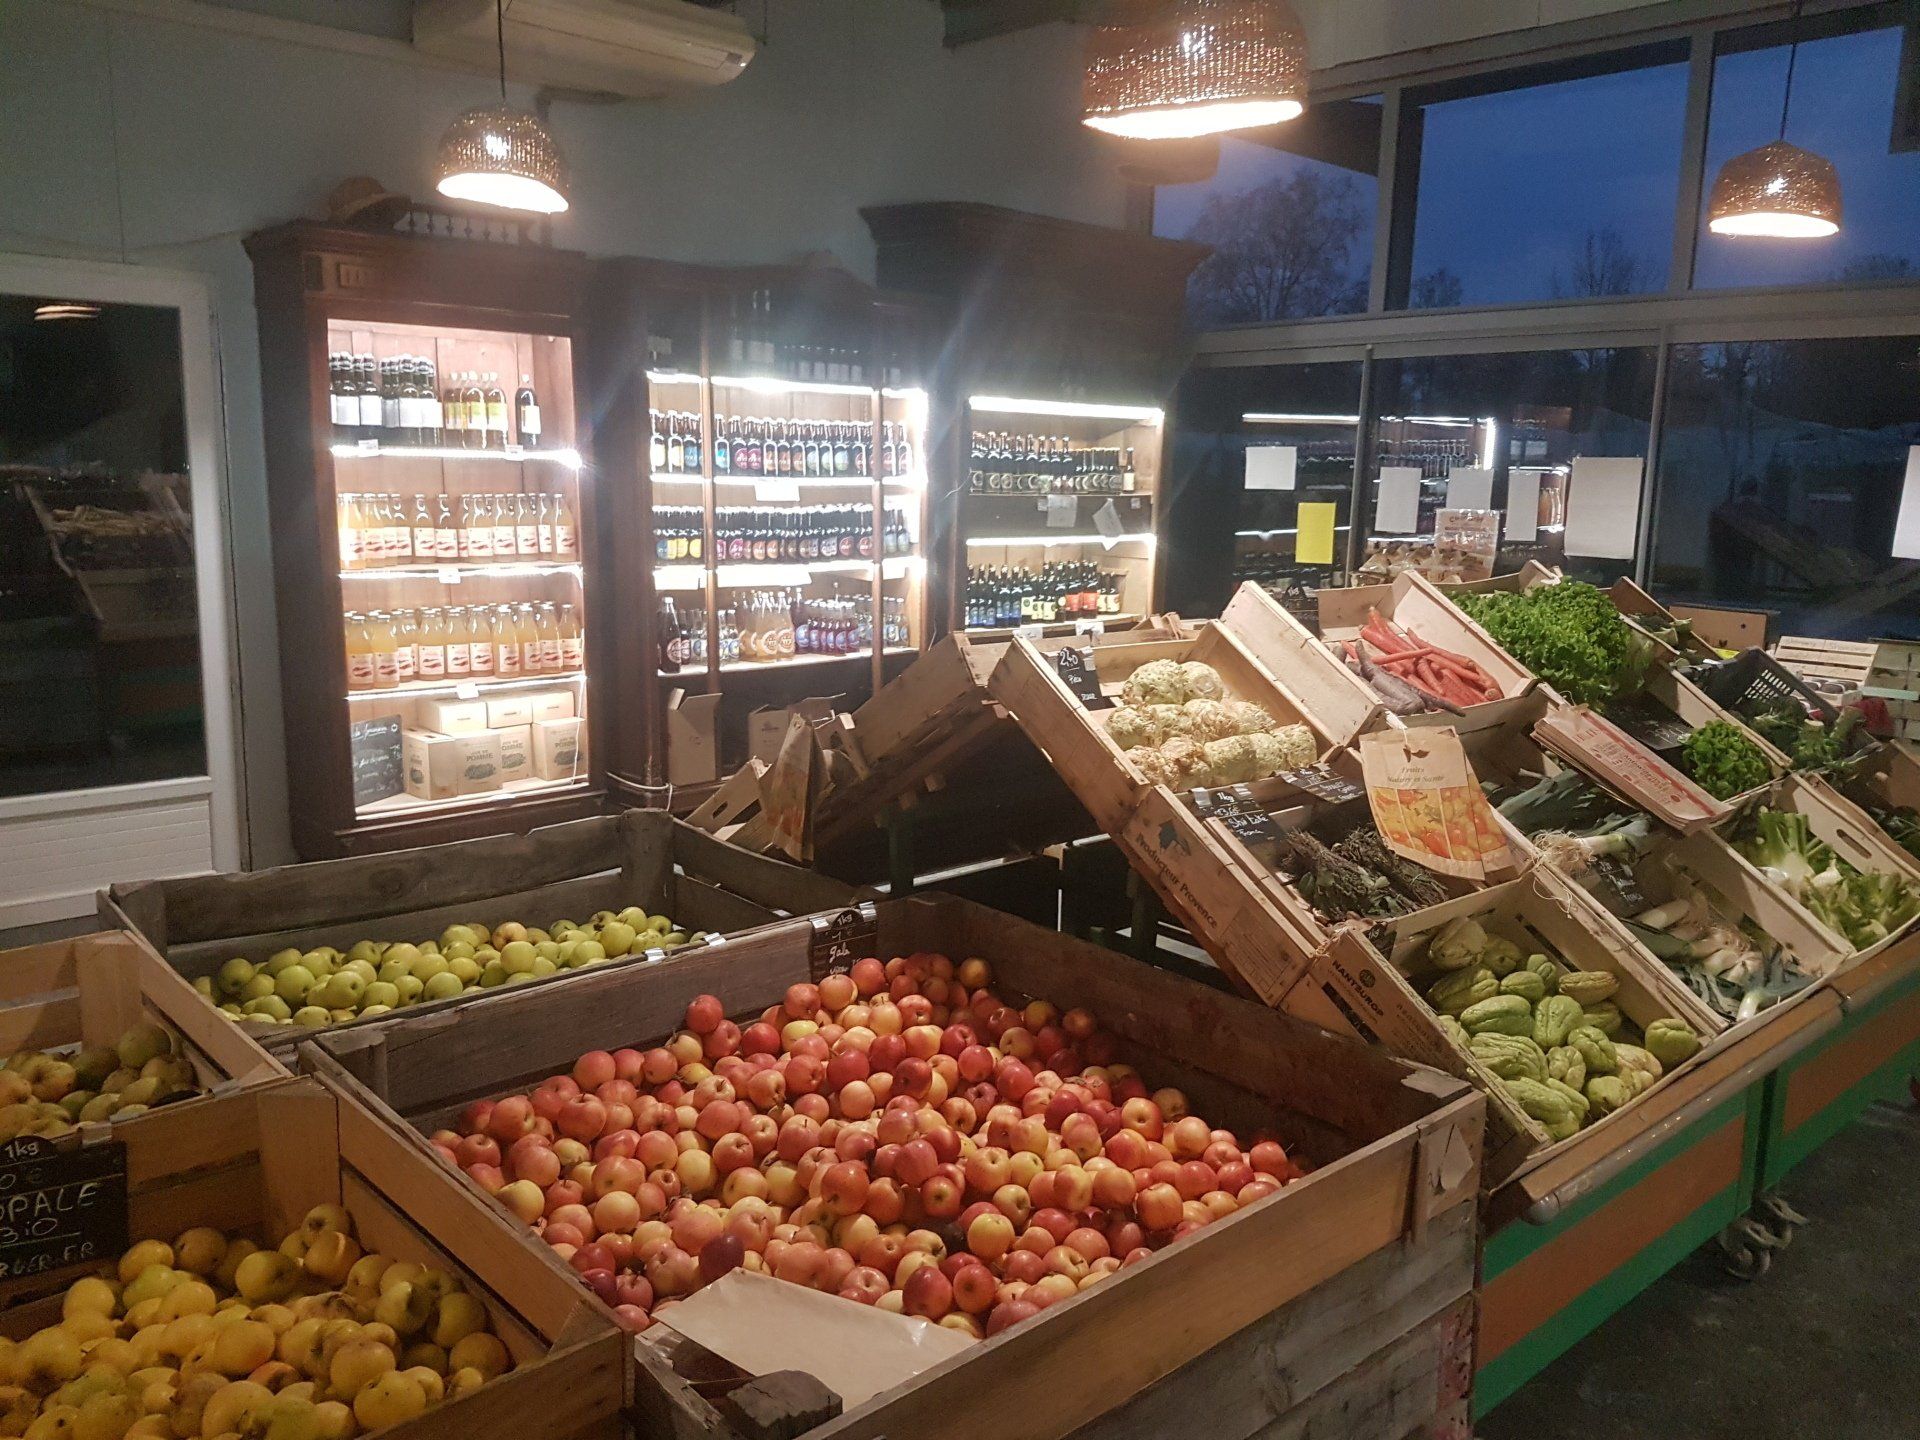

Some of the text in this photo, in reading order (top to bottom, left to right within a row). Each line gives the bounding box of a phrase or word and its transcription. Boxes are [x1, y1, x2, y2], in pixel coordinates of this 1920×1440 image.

[466, 753, 495, 762] POMME
[1216, 791, 1235, 803] 1kg
[1180, 883, 1219, 929] Provence
[837, 913, 853, 926] 1kg
[4, 1140, 40, 1161] 1kg
[0, 1183, 101, 1222] PALE
